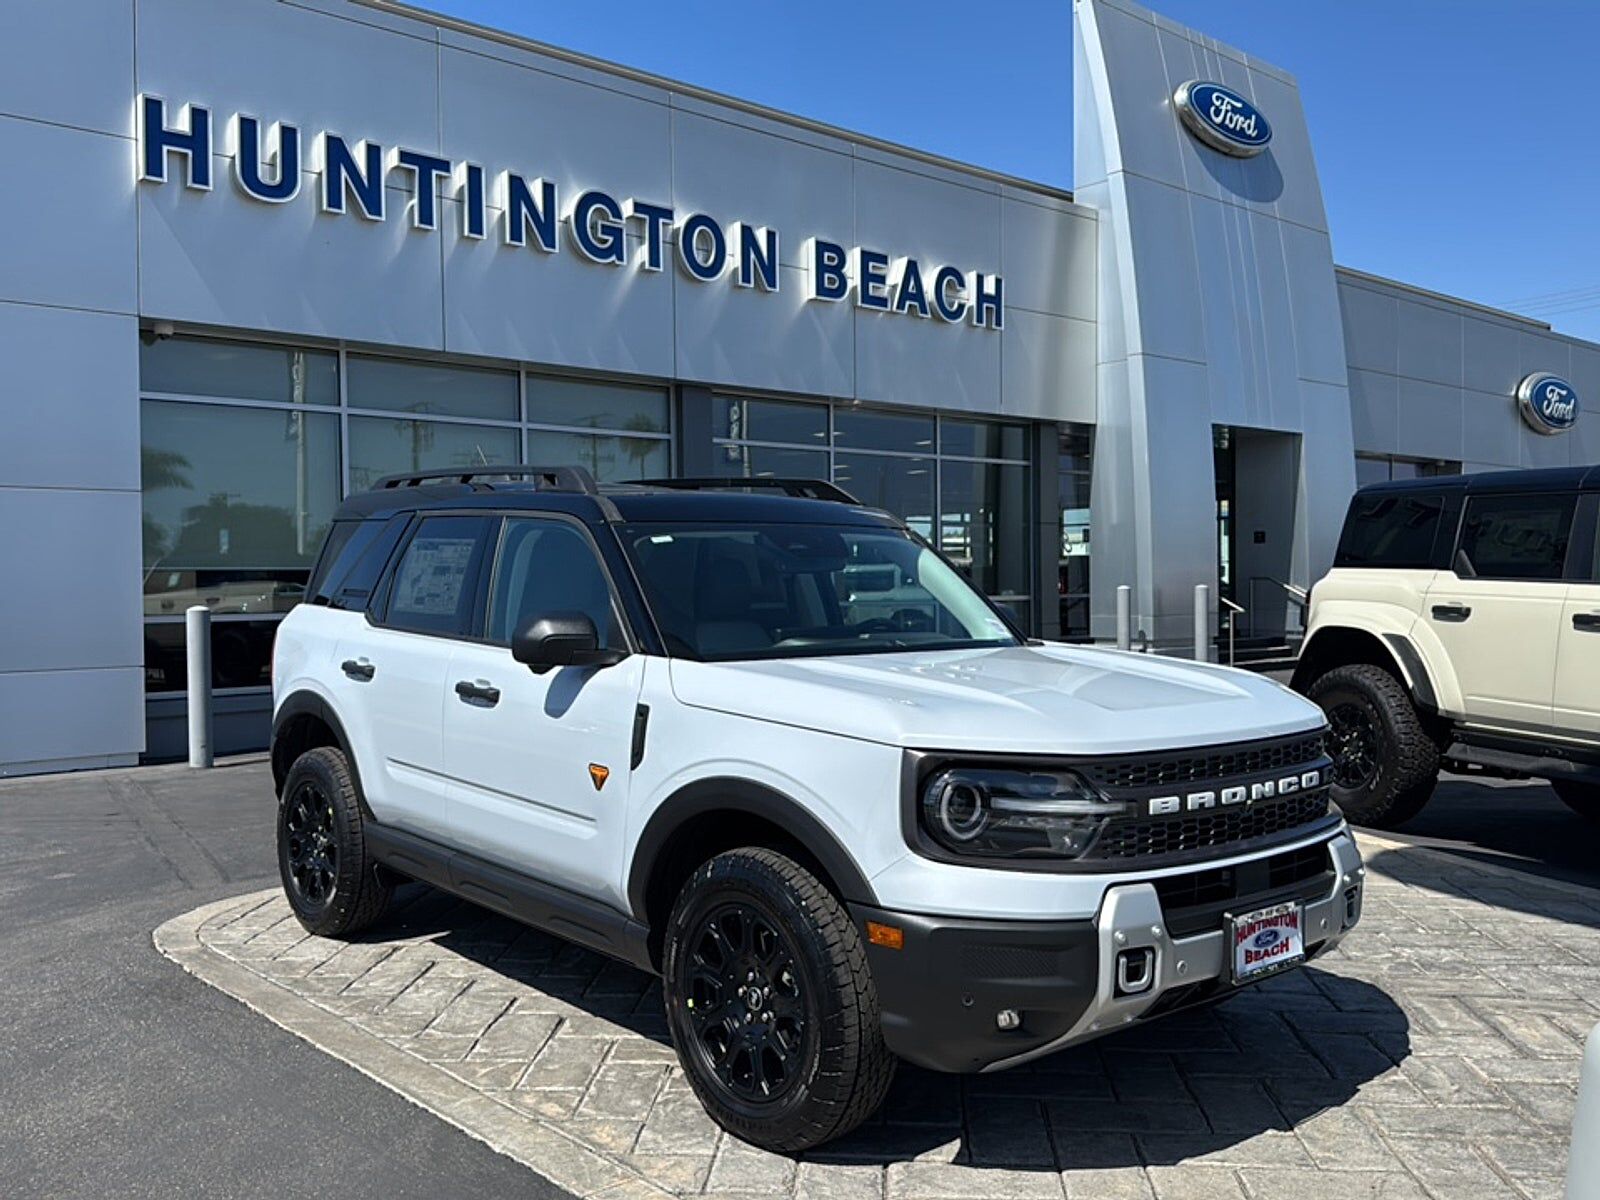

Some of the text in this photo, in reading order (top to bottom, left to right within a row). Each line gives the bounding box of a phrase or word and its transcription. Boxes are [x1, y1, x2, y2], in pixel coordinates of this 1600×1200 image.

[1209, 92, 1258, 138] Ford
[138, 94, 1004, 330] HUNTINGTON BEACH
[1543, 385, 1575, 420] Ford
[1149, 771, 1320, 816] BRONCO
[1235, 911, 1298, 945] HUNTINGTON
[1244, 937, 1290, 965] BEACH
